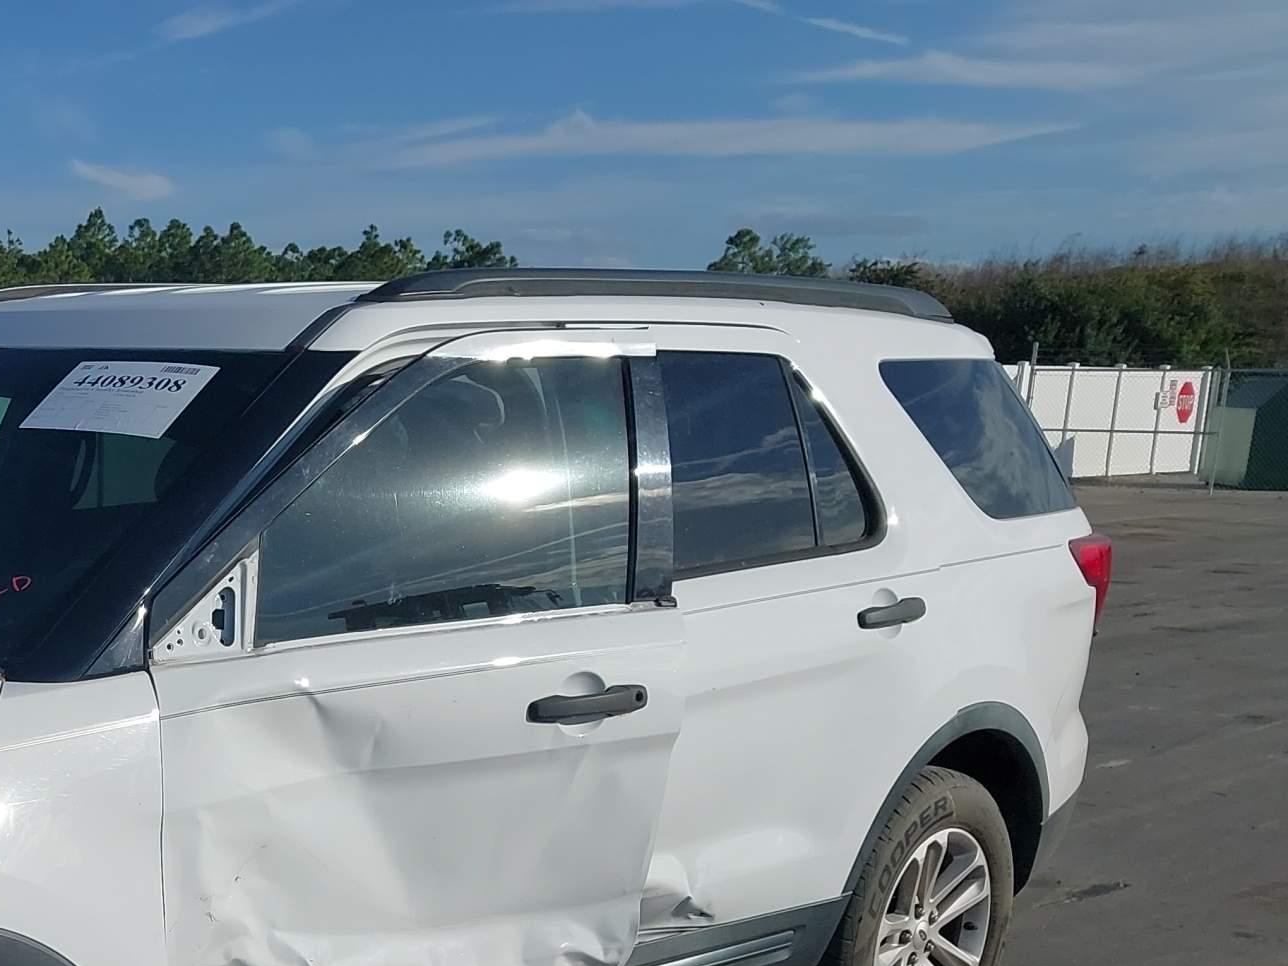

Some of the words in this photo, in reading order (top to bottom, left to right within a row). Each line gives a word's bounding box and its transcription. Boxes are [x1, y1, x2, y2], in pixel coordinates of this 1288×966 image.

[73, 374, 187, 393] 44089308
[1177, 394, 1195, 411] STOP
[869, 796, 948, 920] COOPER
